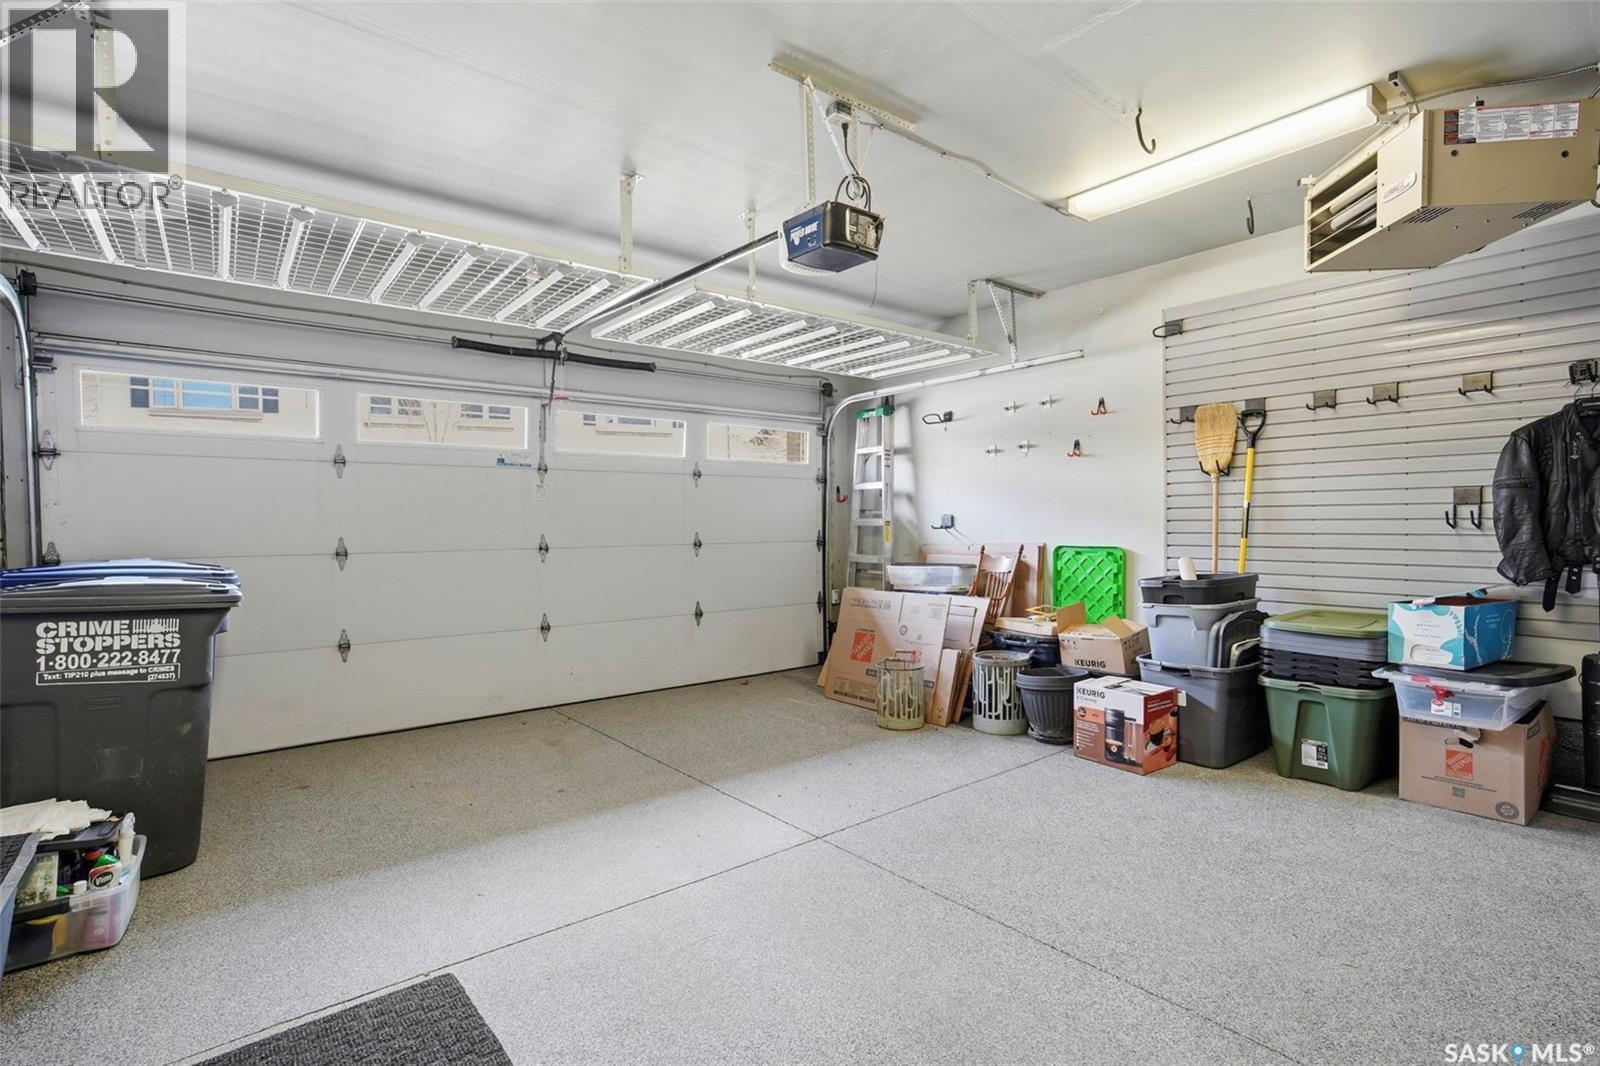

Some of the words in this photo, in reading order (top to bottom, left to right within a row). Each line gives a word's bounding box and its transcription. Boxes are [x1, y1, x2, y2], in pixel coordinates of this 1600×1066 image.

[36, 619, 130, 638] CRIME
[36, 632, 181, 655] STOPPERS
[1074, 658, 1106, 669] KEURIG
[43, 673, 63, 681] Text:
[64, 671, 89, 679] TIP210
[90, 670, 106, 678] plus
[107, 668, 138, 676] message
[148, 665, 175, 673] CRIMES
[1076, 686, 1106, 699] KEURIG
